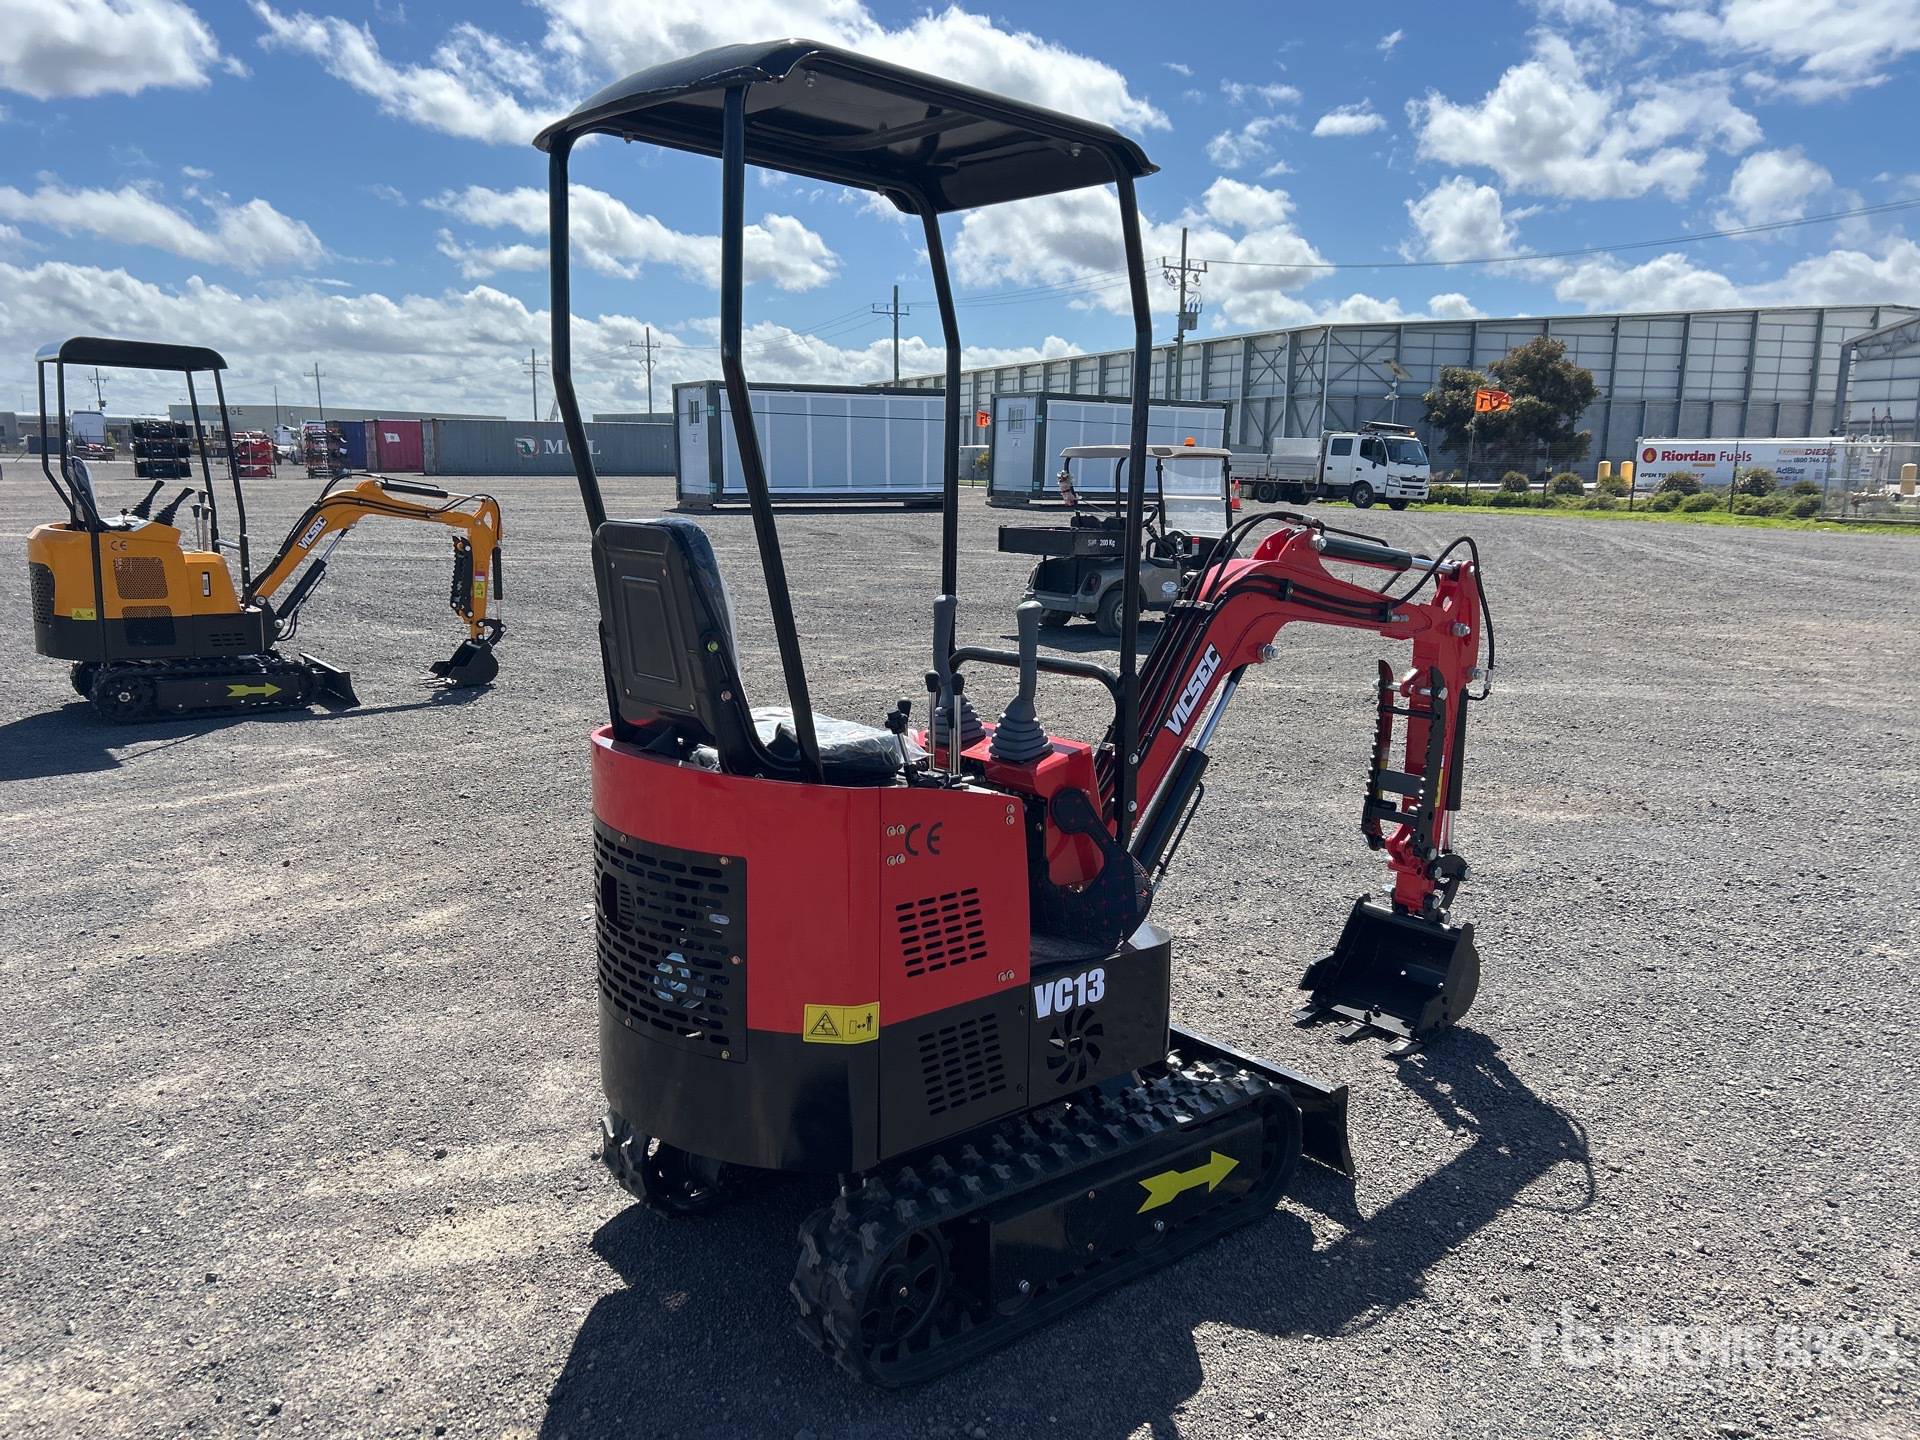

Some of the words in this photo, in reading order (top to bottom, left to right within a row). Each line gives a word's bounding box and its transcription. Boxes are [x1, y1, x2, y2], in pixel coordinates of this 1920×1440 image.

[543, 439, 601, 455] ML
[1661, 450, 1716, 462] Riordan
[1719, 450, 1752, 462] Fuels
[1776, 466, 1806, 475] AdBlue
[297, 515, 328, 550] VICSEC
[110, 540, 128, 551] CE
[1164, 642, 1222, 736] VICSEC
[904, 821, 943, 857] CE
[1033, 967, 1105, 1019] VC13
